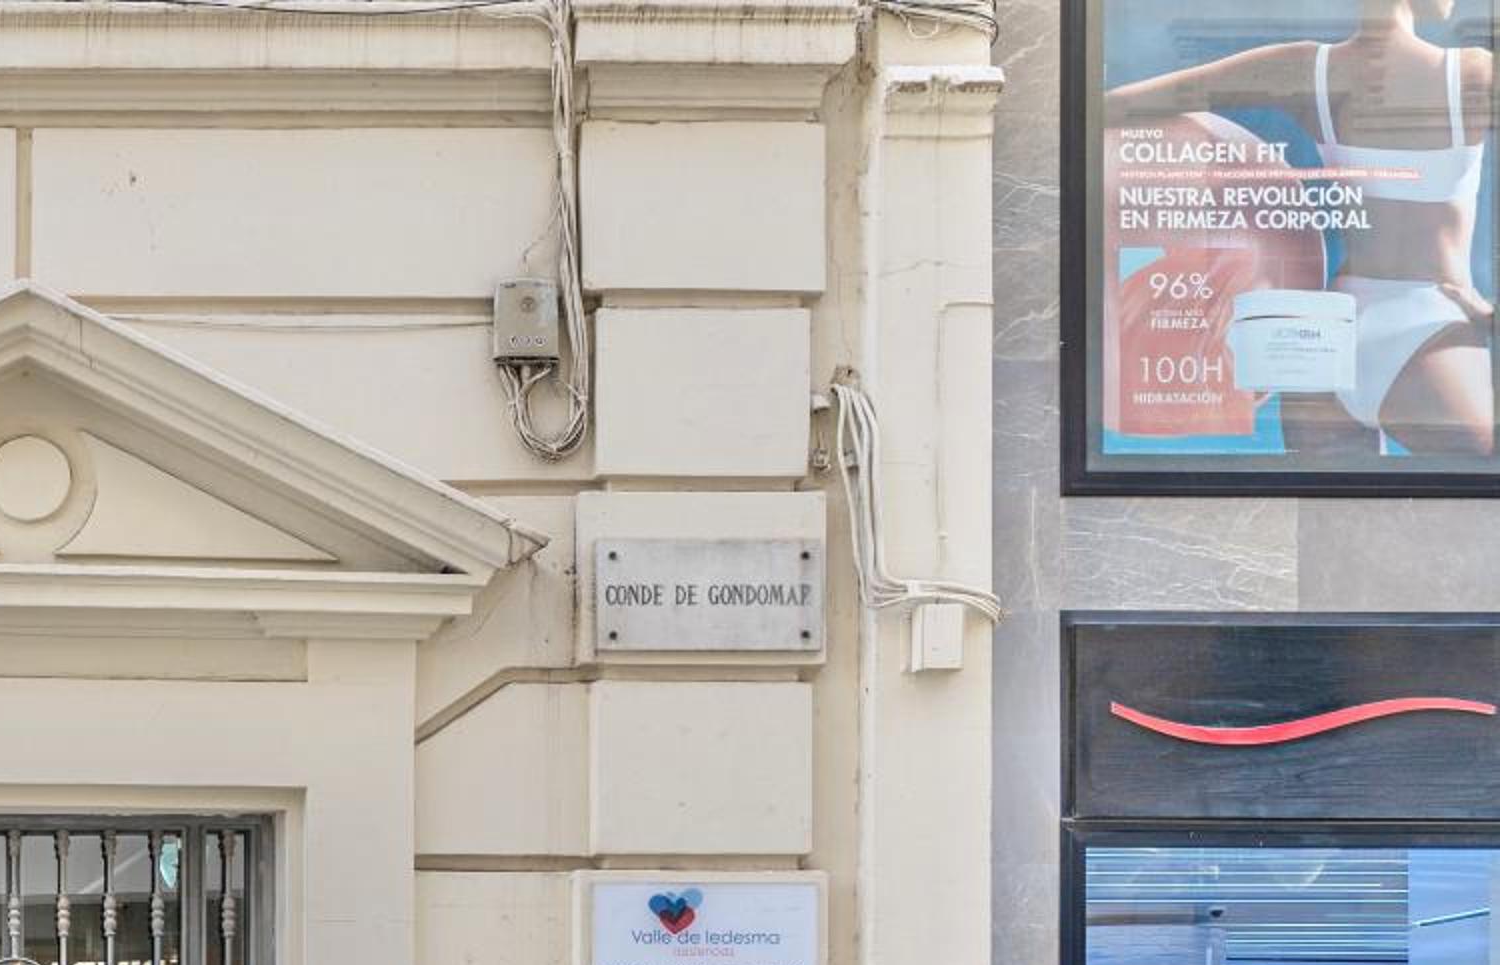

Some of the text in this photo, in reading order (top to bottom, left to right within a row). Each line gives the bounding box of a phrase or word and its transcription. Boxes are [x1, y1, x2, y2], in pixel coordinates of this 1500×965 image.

[1120, 129, 1163, 139] NUEVO
[1120, 142, 1288, 163] COLLAGEN FIT
[1120, 181, 1363, 206] NUESTRA REVOLUCIÓN
[1120, 209, 1371, 230] EN FIRMEZA CORPORAL
[1150, 273, 1214, 299] 96%
[1151, 319, 1210, 330] FIRMEZA
[1140, 356, 1222, 384] 100H
[605, 584, 813, 606] CONDE DE GONDOMAR
[631, 930, 781, 945] Valle de ledesma
